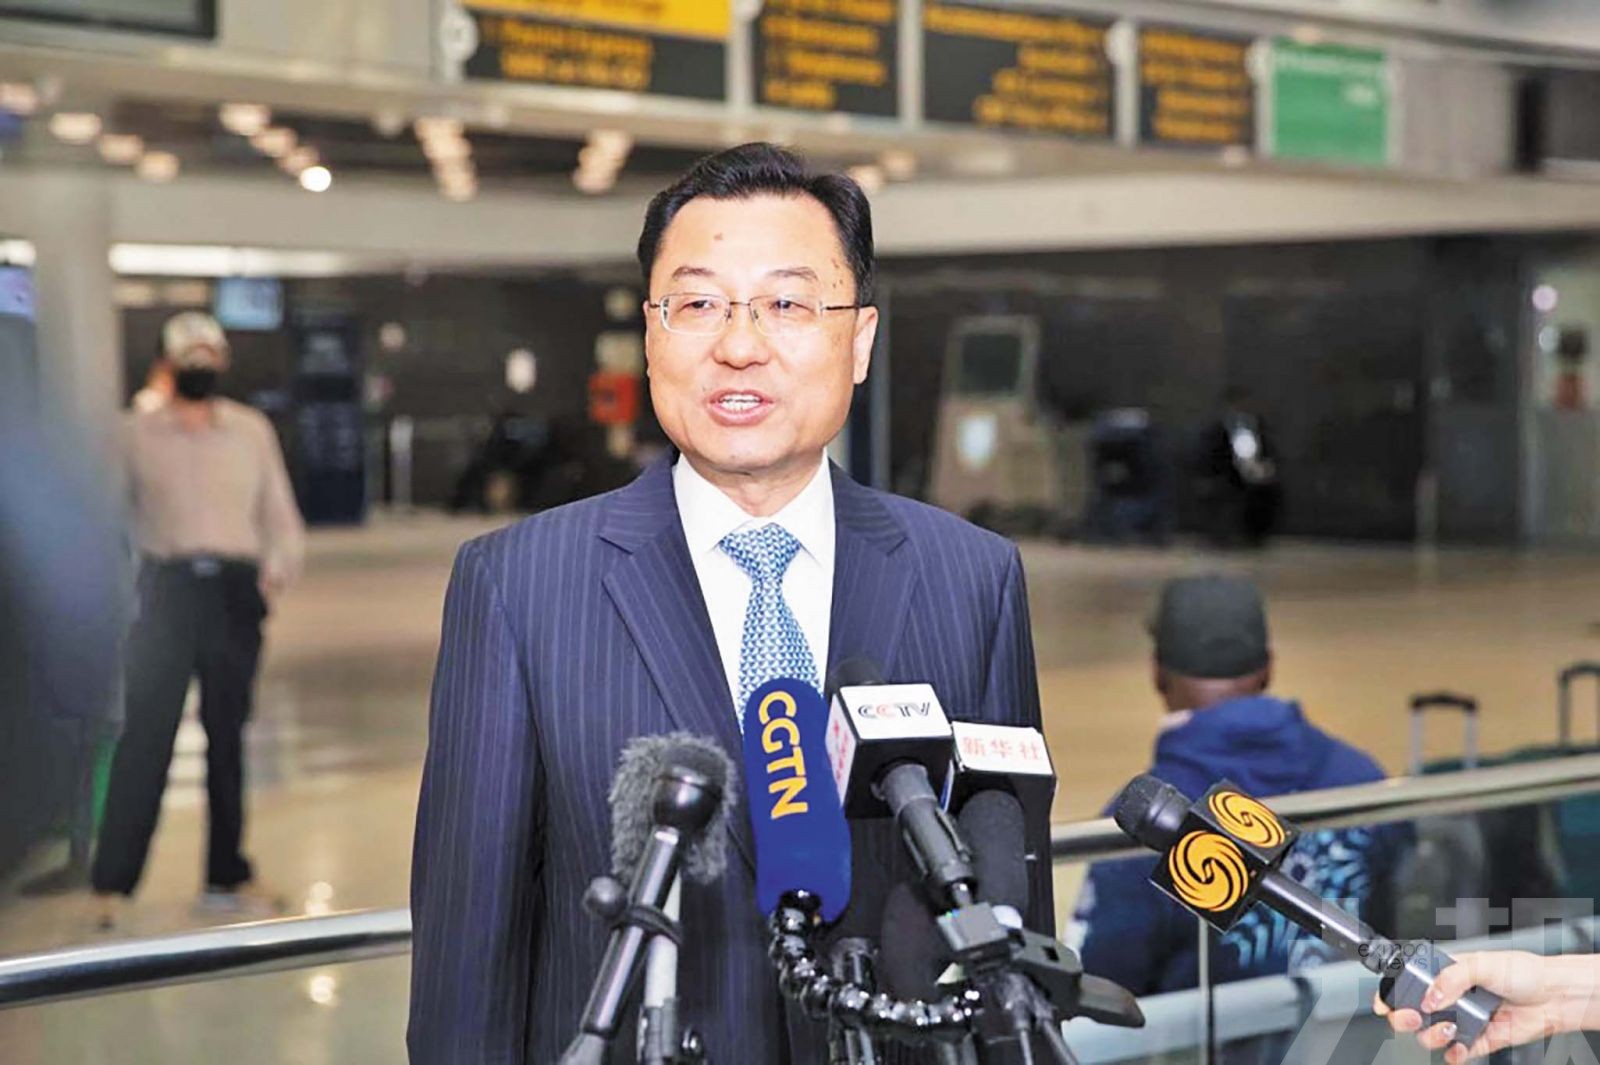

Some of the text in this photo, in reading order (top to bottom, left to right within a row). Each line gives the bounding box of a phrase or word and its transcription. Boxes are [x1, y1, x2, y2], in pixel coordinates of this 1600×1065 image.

[857, 701, 931, 719] CCTV
[758, 690, 808, 820] CGTN
[963, 736, 1043, 760] 新华社
